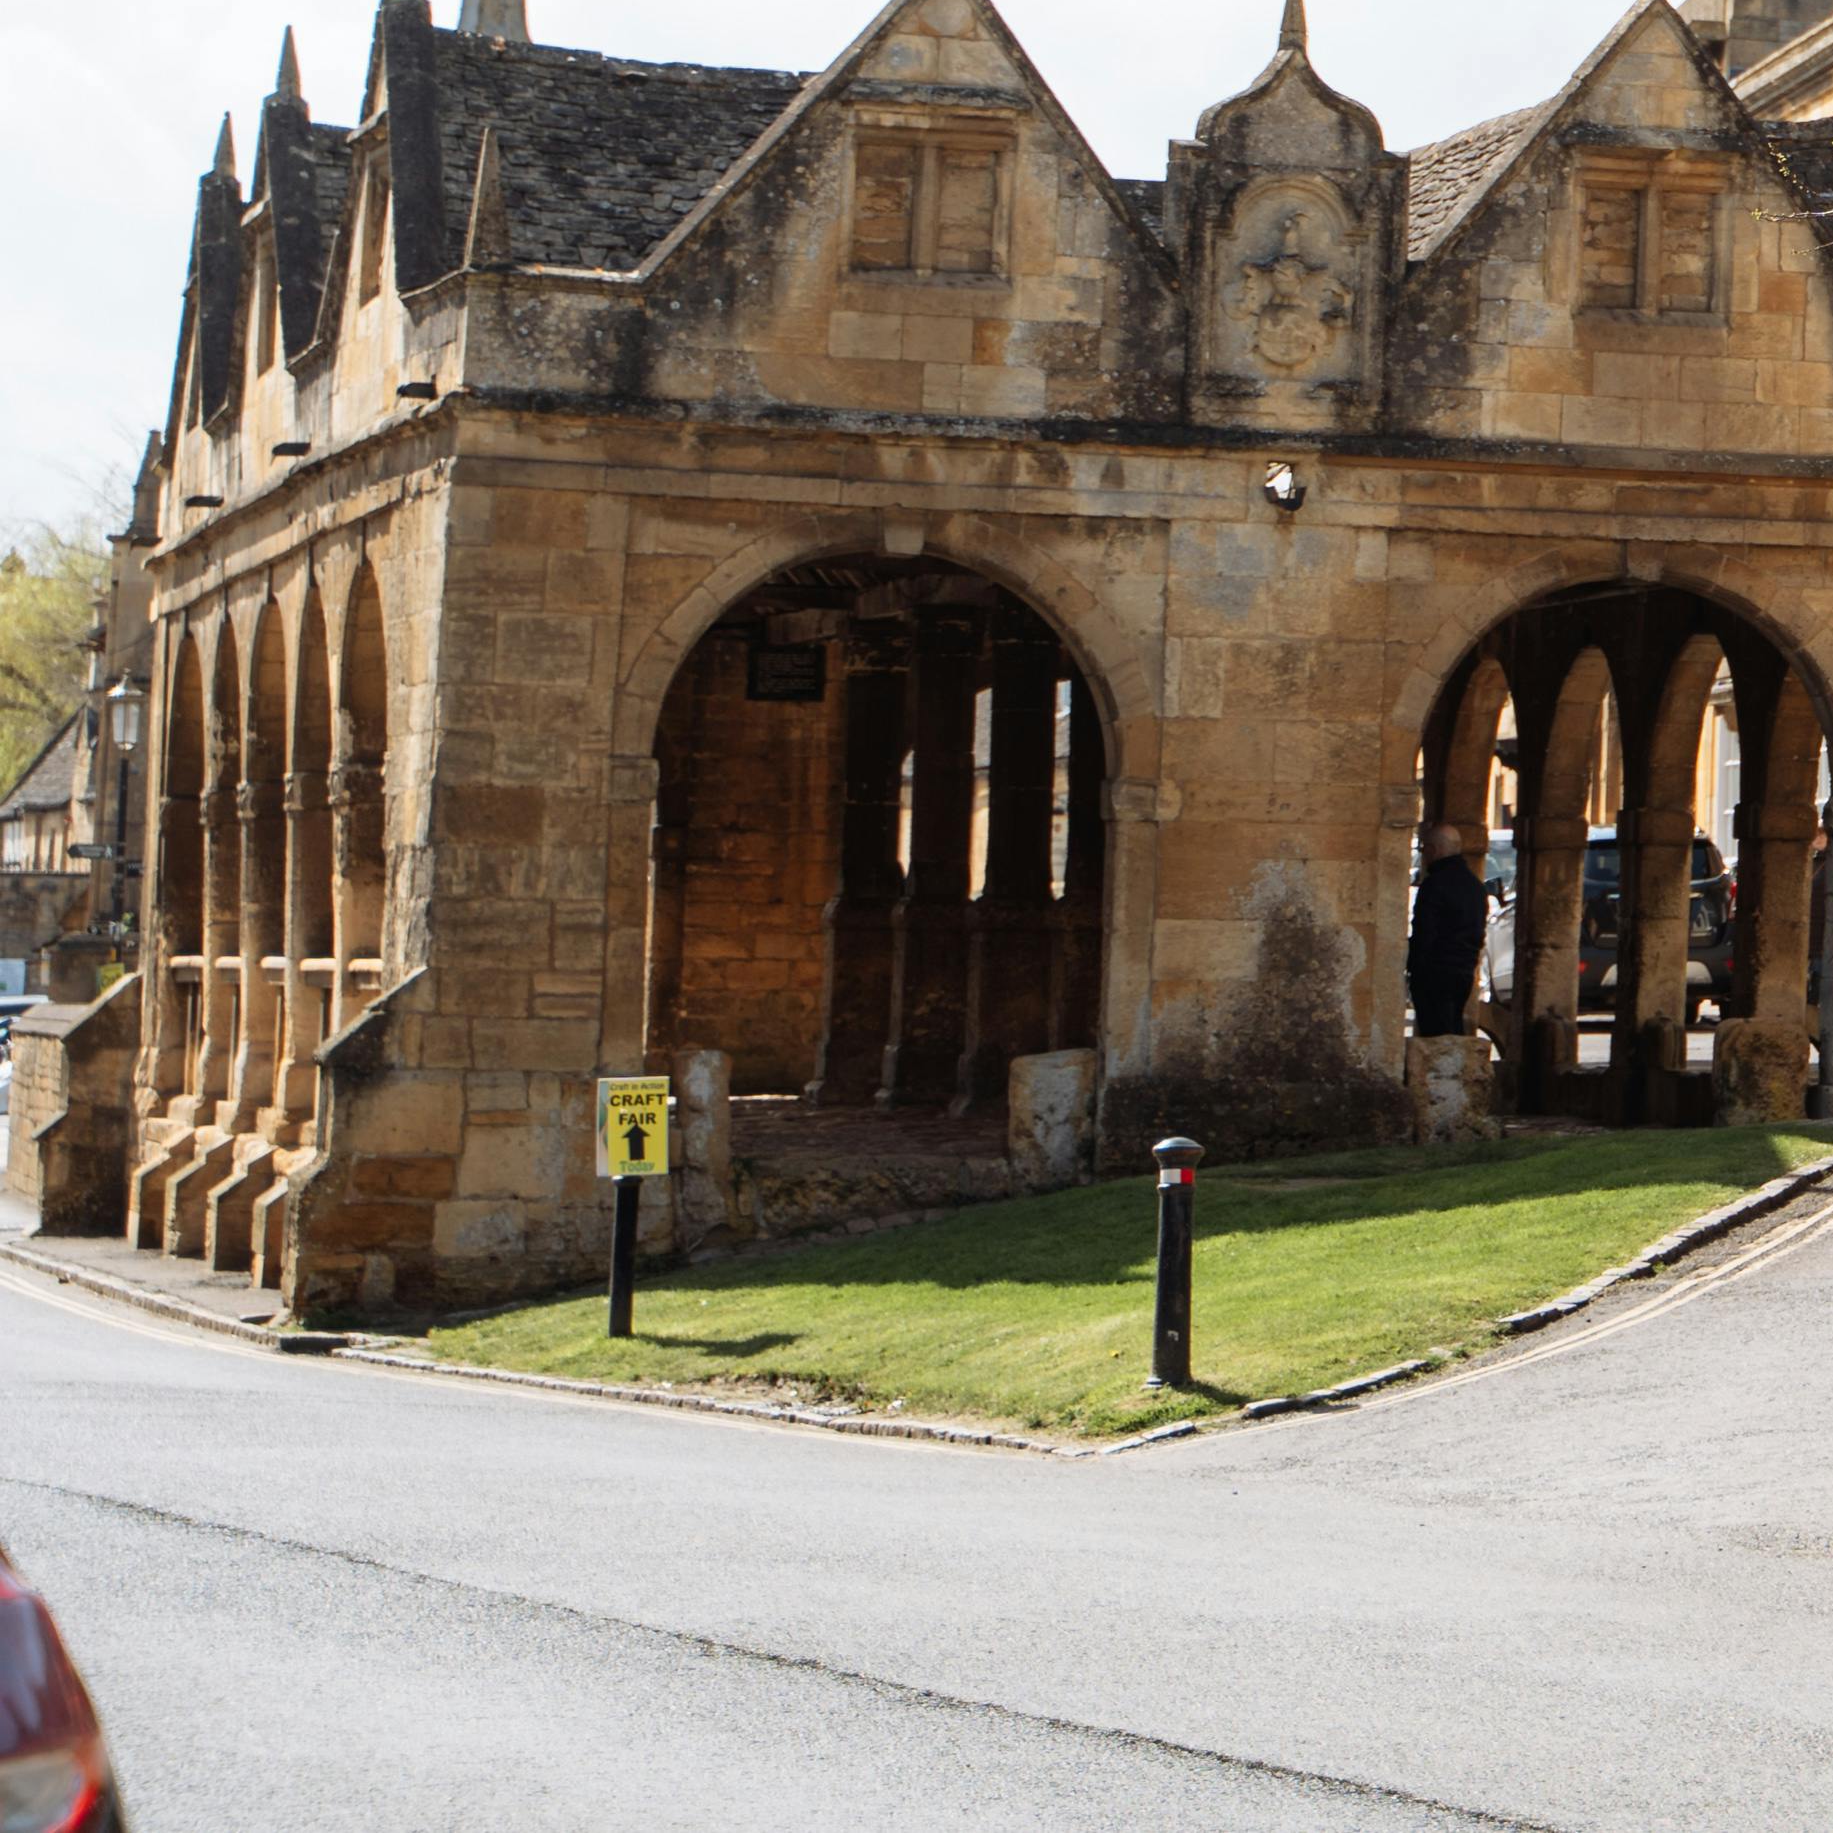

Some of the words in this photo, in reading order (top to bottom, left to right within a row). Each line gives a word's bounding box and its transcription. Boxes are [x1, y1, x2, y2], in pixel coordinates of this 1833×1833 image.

[610, 1094, 666, 1106] CRAFT
[619, 1113, 656, 1125] FAIR
[619, 1161, 655, 1172] Today
